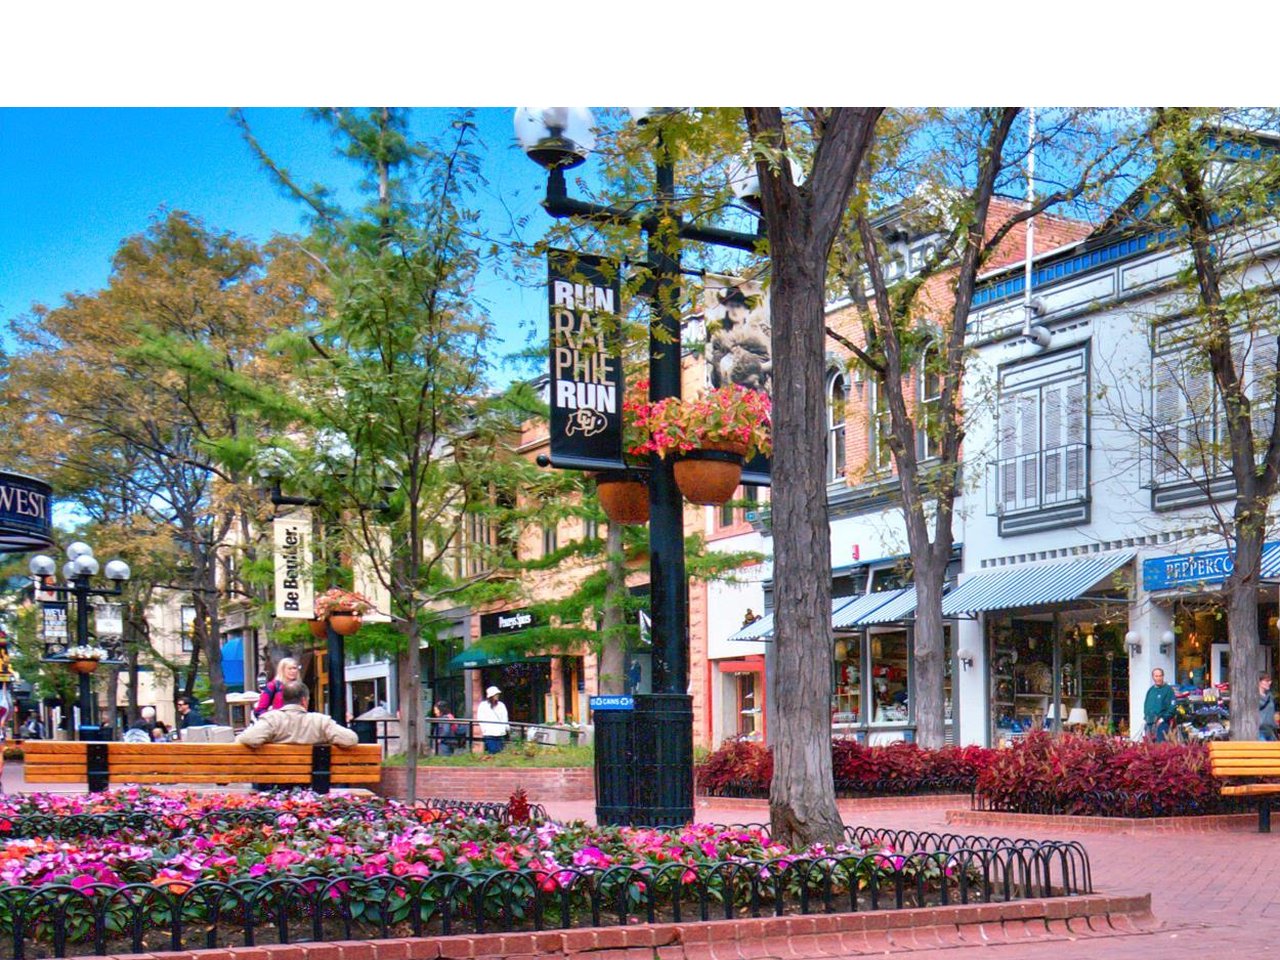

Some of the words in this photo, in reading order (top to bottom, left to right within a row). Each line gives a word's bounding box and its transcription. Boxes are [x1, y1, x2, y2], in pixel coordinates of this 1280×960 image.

[554, 280, 614, 315] RUN
[556, 347, 616, 387] PHIE
[557, 380, 616, 414] RUN
[0, 486, 46, 518] WEST
[1166, 556, 1234, 580] PEPPERCO
[284, 591, 299, 611] Be
